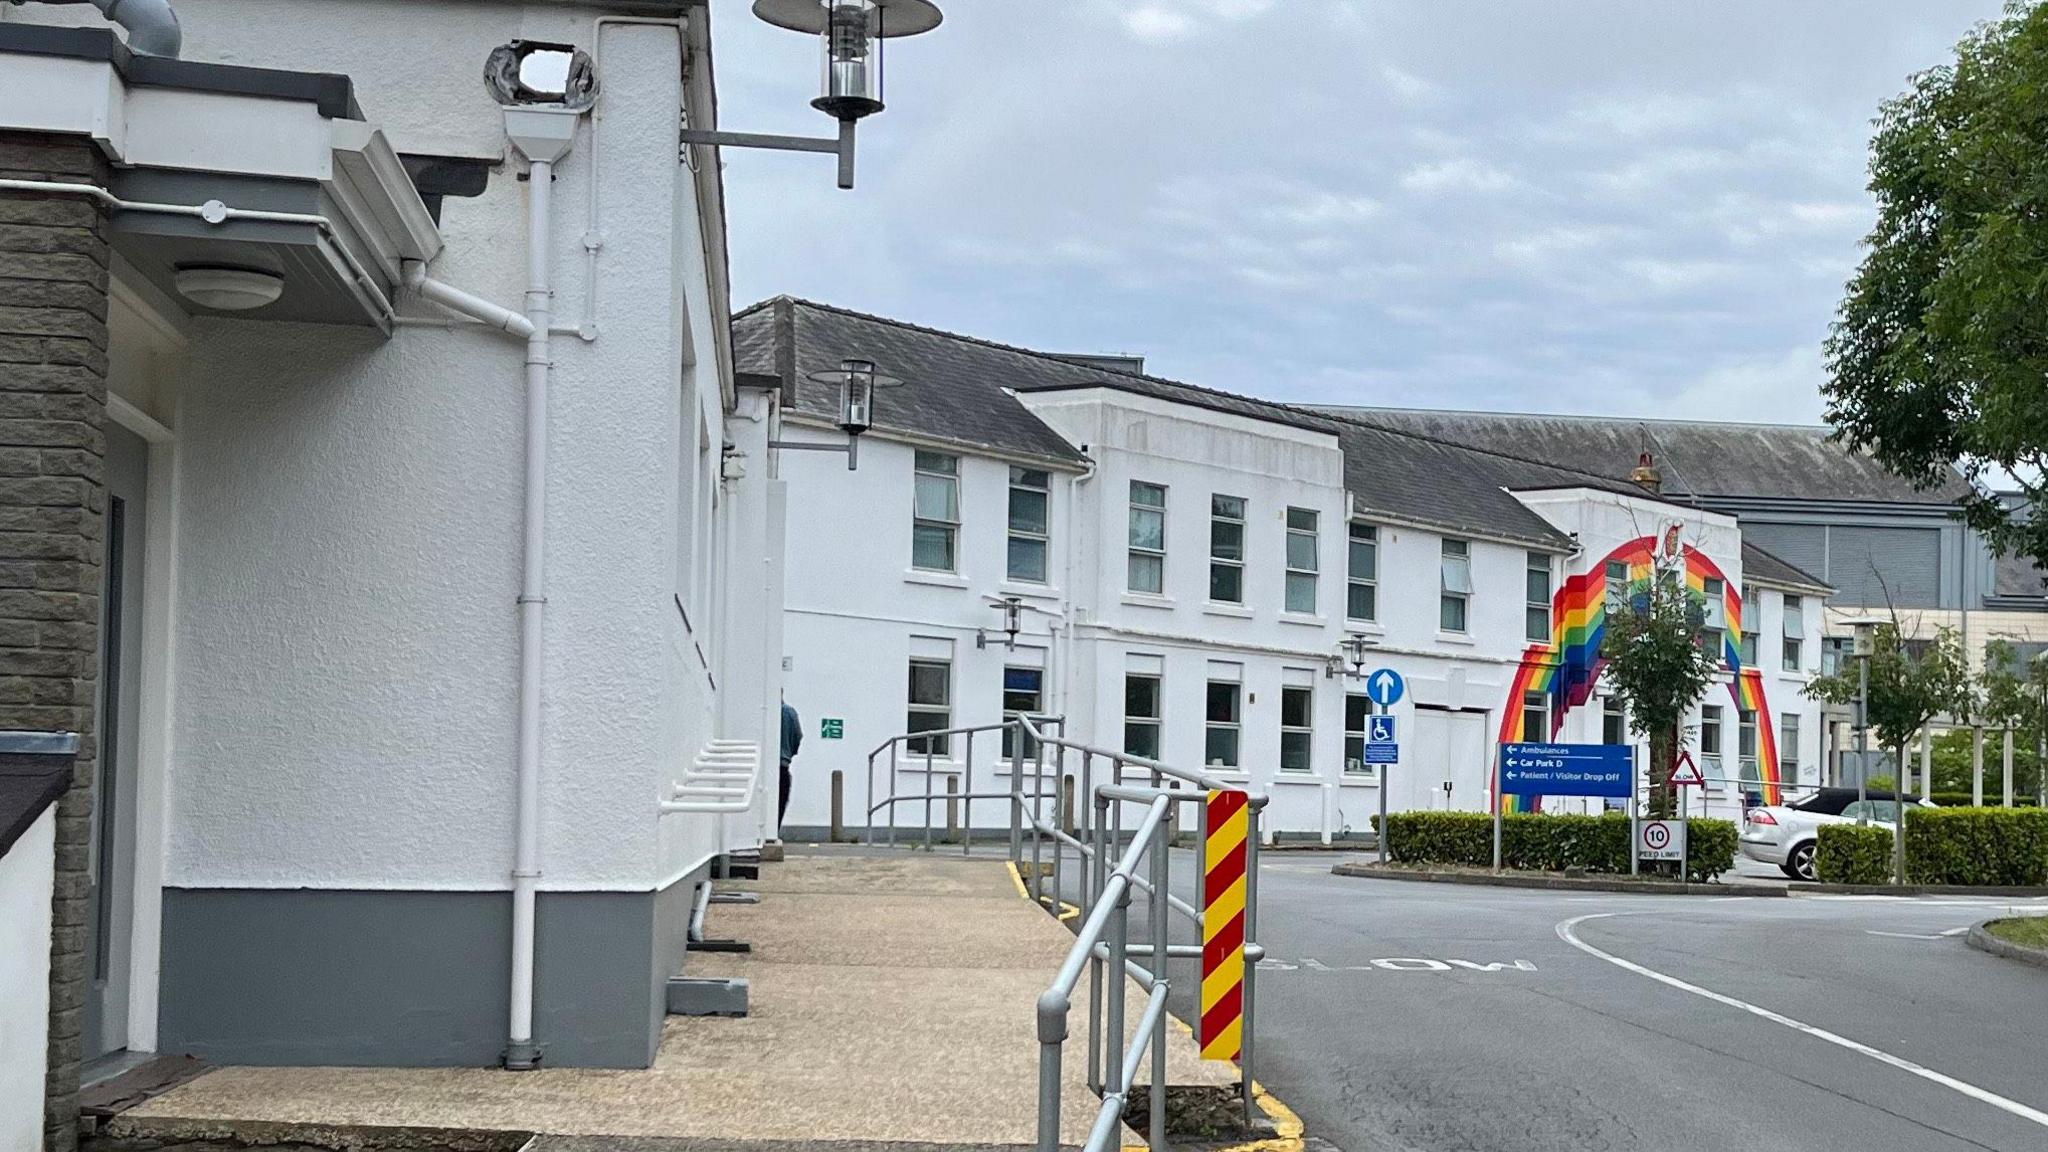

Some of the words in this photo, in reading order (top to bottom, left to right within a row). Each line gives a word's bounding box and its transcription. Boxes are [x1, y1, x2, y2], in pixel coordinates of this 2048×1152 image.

[1520, 746, 1569, 754] Ambulances
[1520, 772, 1548, 780] Patient
[1555, 772, 1582, 780] Visitor
[1584, 773, 1604, 782] Drop
[1650, 830, 1665, 842] 10
